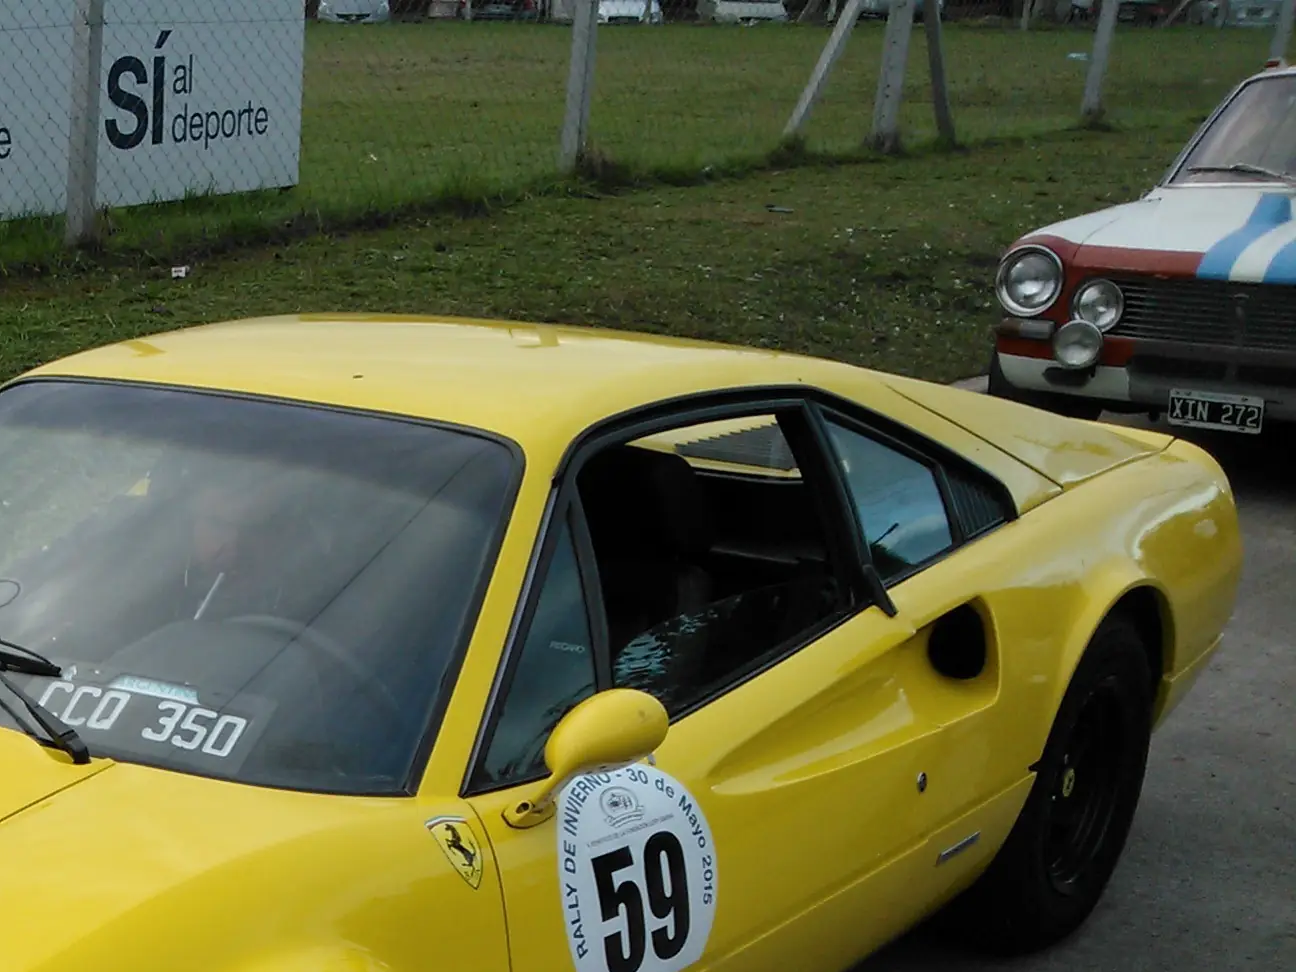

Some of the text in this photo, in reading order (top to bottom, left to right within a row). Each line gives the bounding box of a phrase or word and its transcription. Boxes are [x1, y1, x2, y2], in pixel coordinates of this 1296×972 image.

[104, 29, 193, 151] SÍ al
[170, 100, 270, 151] deporte
[1172, 398, 1259, 427] XIN 272
[141, 700, 248, 757] 350
[626, 768, 649, 785] 30
[654, 777, 675, 798] de
[563, 774, 612, 837] INVIERNO
[678, 796, 707, 849] Mayo
[563, 839, 577, 875] DE
[701, 855, 714, 905] 2015
[566, 883, 589, 959] RALLY
